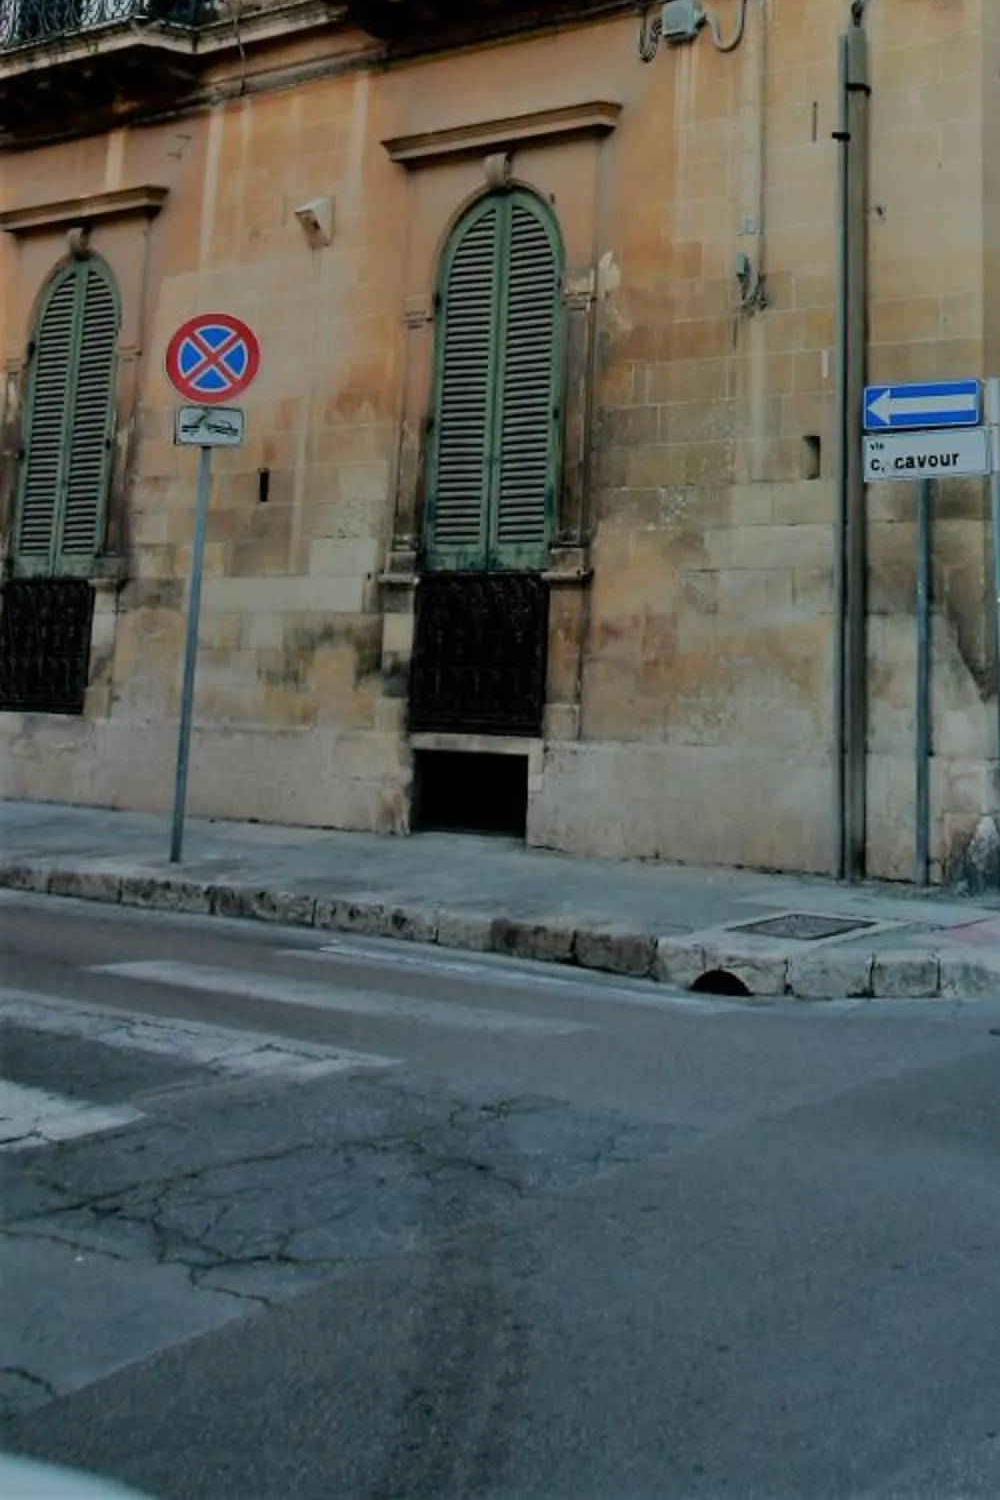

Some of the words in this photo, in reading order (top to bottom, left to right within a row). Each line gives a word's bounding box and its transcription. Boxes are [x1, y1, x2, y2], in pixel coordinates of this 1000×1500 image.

[868, 442, 885, 451] via
[869, 457, 885, 472] c.
[894, 452, 961, 470] cavour
